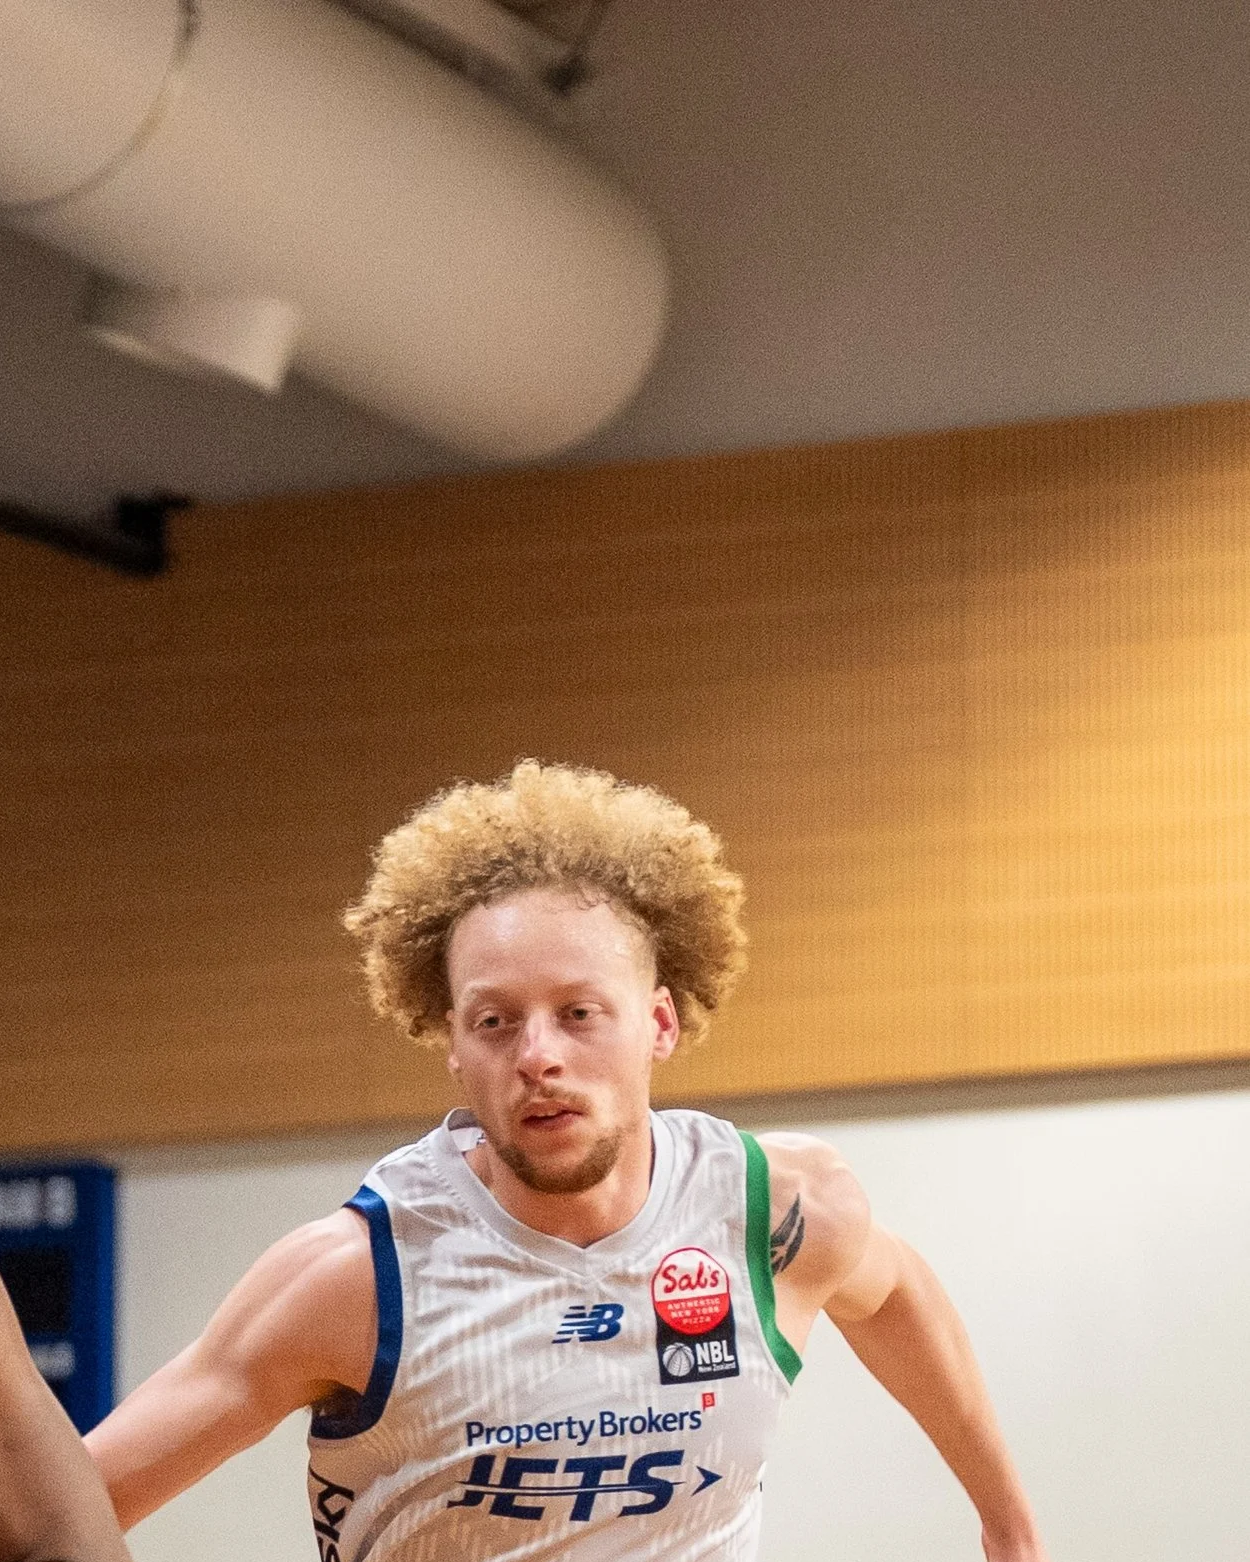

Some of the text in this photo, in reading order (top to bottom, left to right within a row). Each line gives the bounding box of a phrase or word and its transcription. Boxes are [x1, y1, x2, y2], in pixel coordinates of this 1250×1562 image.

[661, 1260, 721, 1293] Sal's
[667, 1297, 721, 1311] AUTHENTIC
[670, 1305, 721, 1319] NEW YORK
[681, 1315, 712, 1325] PIZZA
[695, 1339, 735, 1365] NBL
[446, 1449, 686, 1522] JETS
